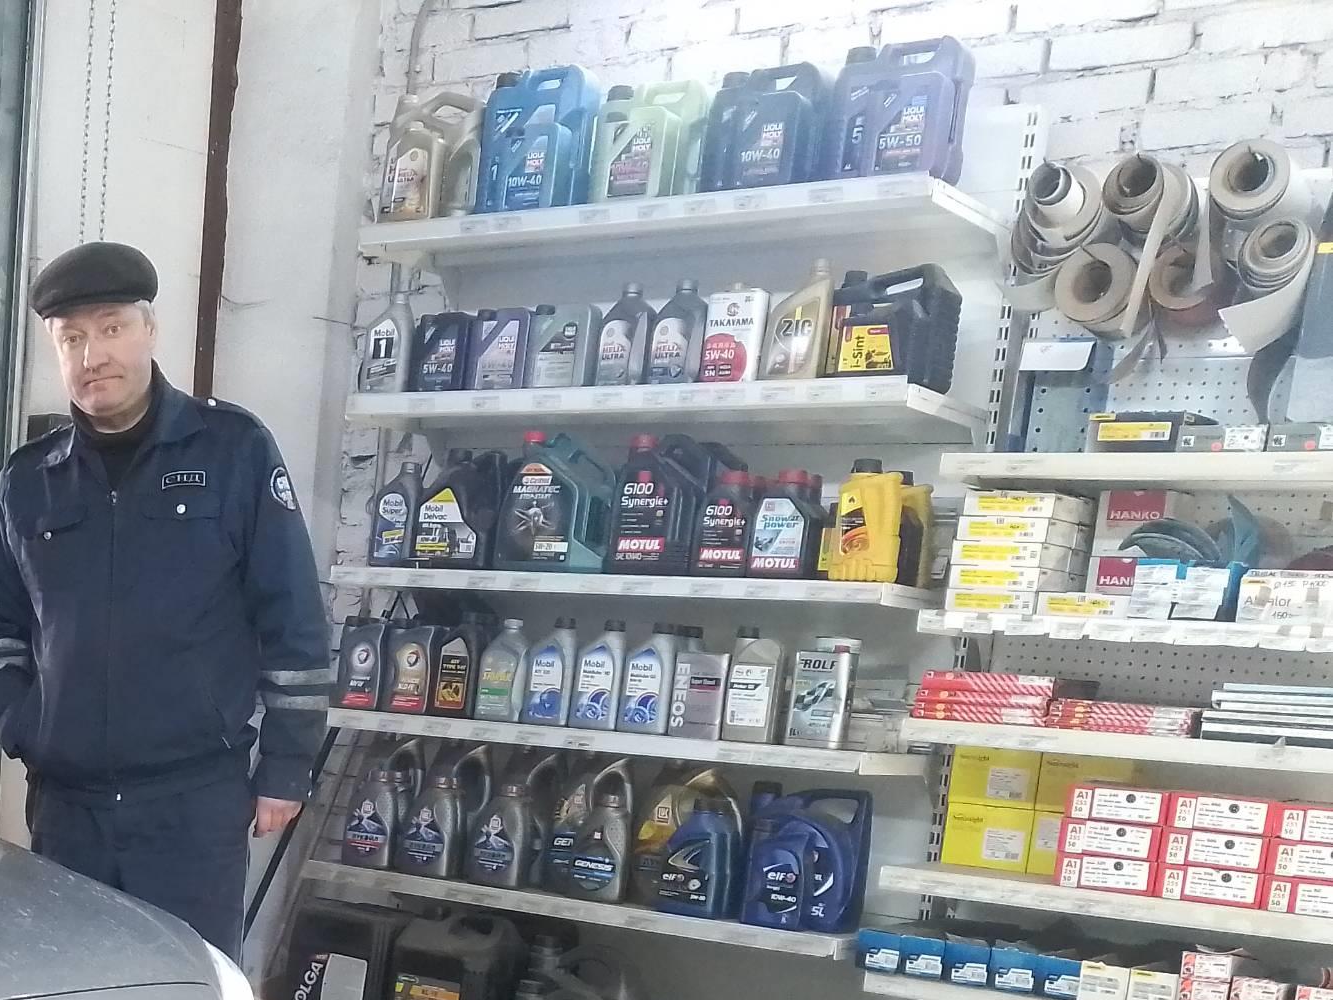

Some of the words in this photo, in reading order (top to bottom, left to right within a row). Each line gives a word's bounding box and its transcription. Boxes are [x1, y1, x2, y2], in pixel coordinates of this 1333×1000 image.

[903, 106, 925, 114] LIQUI
[902, 113, 924, 122] MOLY
[763, 124, 783, 132] LIQUI
[762, 131, 782, 139] MOLY
[633, 137, 651, 145] LIQUI
[879, 134, 921, 151] 5W-50
[527, 152, 544, 160] LIQUI
[740, 148, 780, 162] 10W-40
[508, 175, 542, 187] 10W-40
[708, 317, 754, 328] TAKAYAMA
[779, 318, 812, 337] ZIC
[373, 328, 395, 338] Mobil
[440, 338, 456, 346] LIQUI
[378, 339, 388, 358] 1
[601, 352, 626, 360] ULTRA
[654, 351, 680, 359] ULTRA
[704, 349, 735, 361] 5W-40
[423, 363, 453, 373] 5W-40
[513, 485, 561, 494] MAGNATEC
[623, 482, 654, 495] 6100
[383, 499, 403, 507] Mobil
[620, 496, 669, 508] Synergie+
[425, 504, 443, 513] Mobil
[705, 505, 733, 516] 6100
[424, 513, 447, 521] Delvac
[1110, 510, 1160, 521] HANKO
[702, 516, 746, 528] Synergie+
[763, 522, 799, 530] power
[618, 539, 661, 551] MOTUL
[700, 550, 741, 560] MOTUL
[751, 557, 797, 569] MOTUL
[1099, 576, 1134, 586] HAN
[535, 659, 555, 668] Mobil
[583, 659, 606, 669] Mobil
[631, 663, 653, 671] Mobil
[800, 658, 838, 670] ROLF
[670, 663, 691, 728] ENEOS
[574, 859, 615, 872] GENESIS
[662, 873, 677, 881] elf
[768, 872, 786, 882] elf
[770, 894, 797, 903] 10W-40
